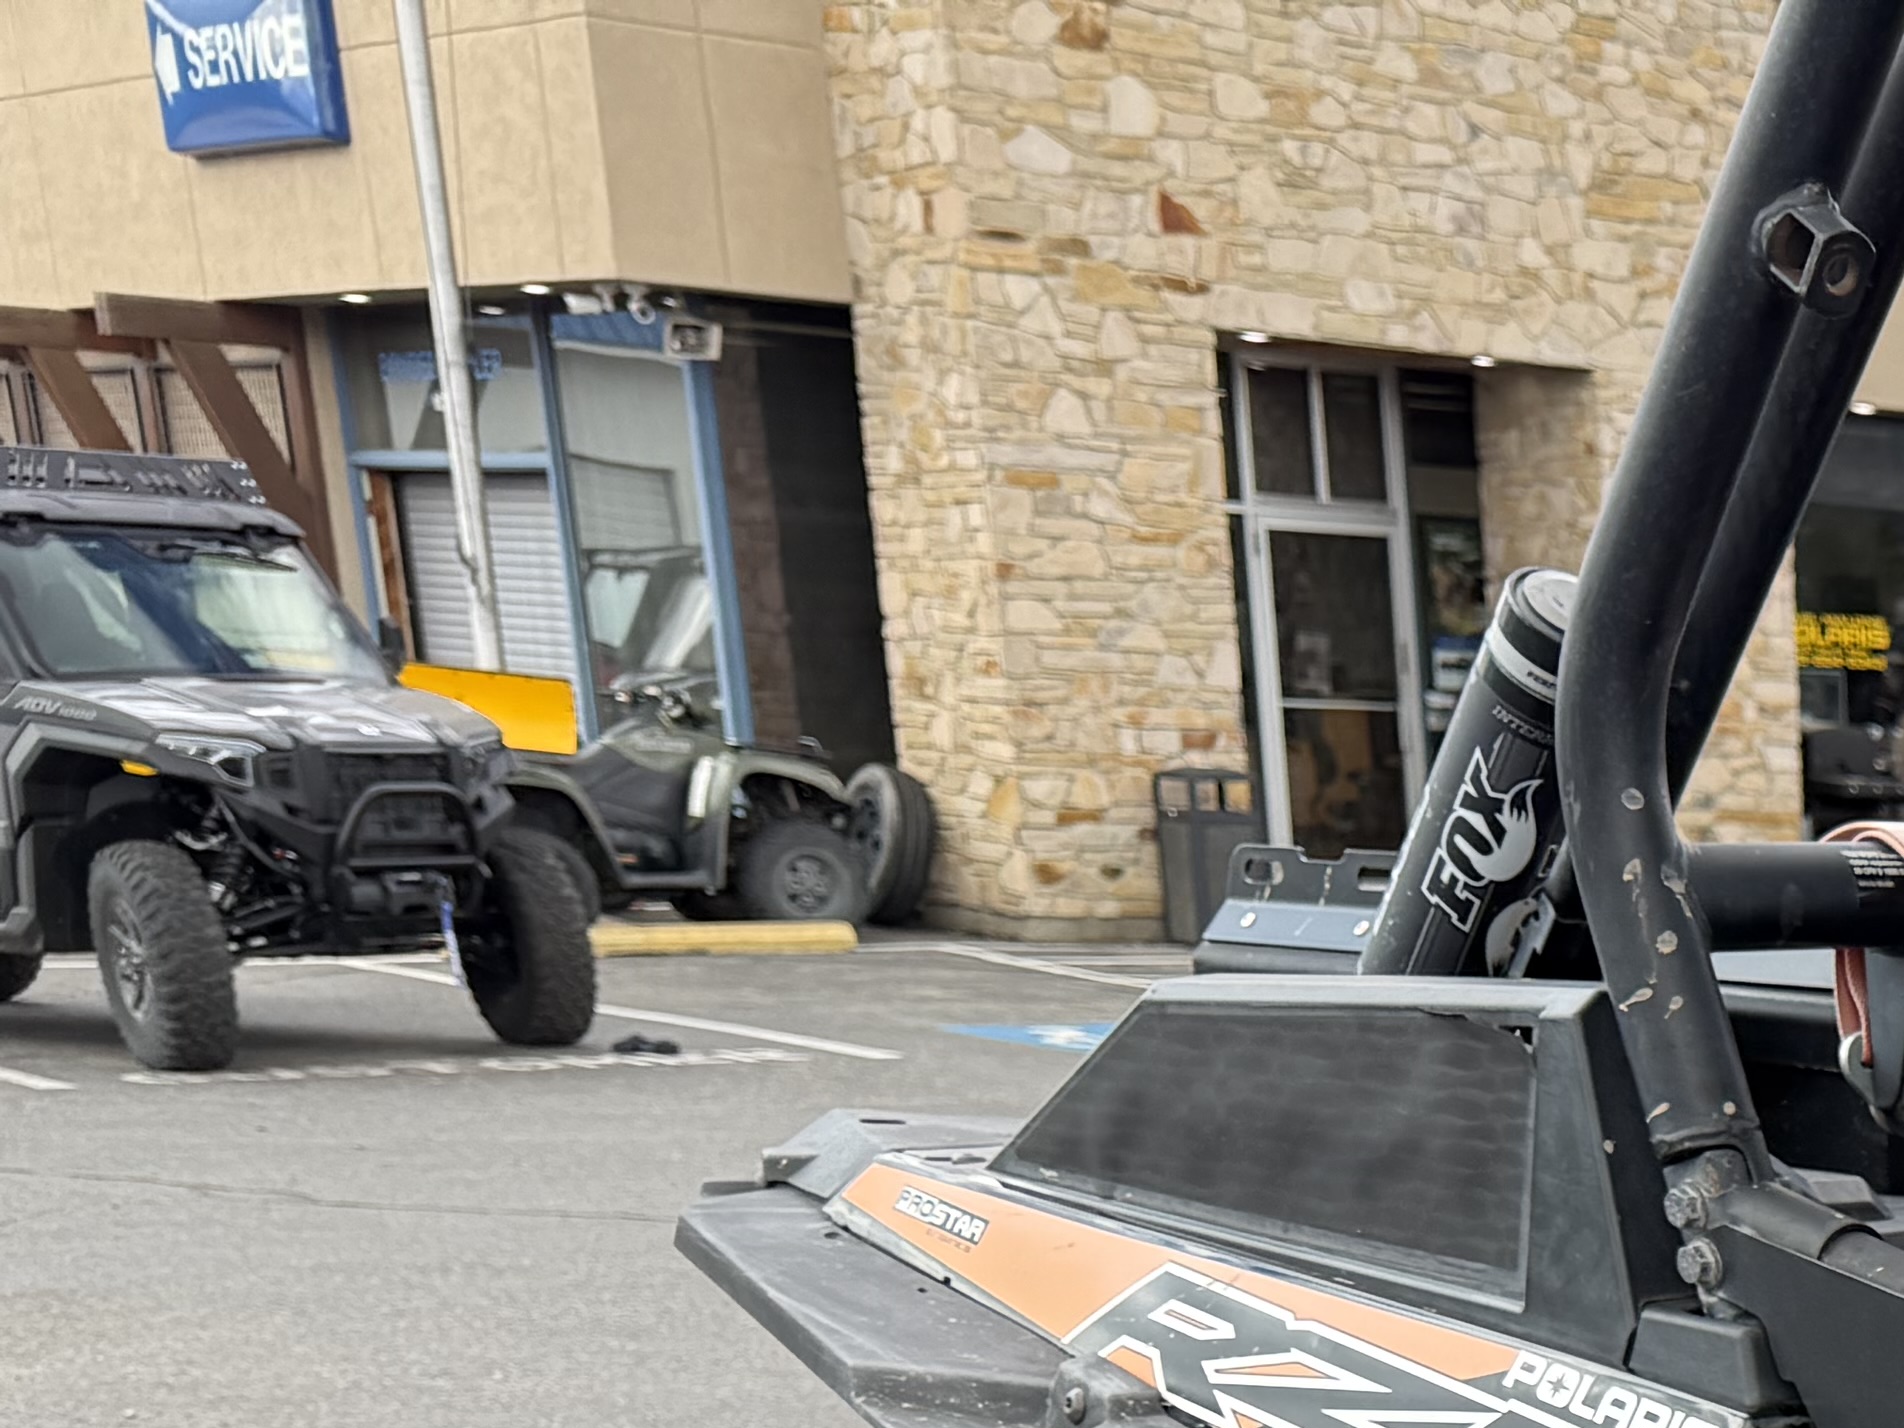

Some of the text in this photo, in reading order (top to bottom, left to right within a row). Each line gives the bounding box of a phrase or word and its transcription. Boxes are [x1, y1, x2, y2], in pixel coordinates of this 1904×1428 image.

[184, 13, 310, 91] SERVICE
[1421, 745, 1525, 934] FOX
[896, 1187, 986, 1244] PROSTAR
